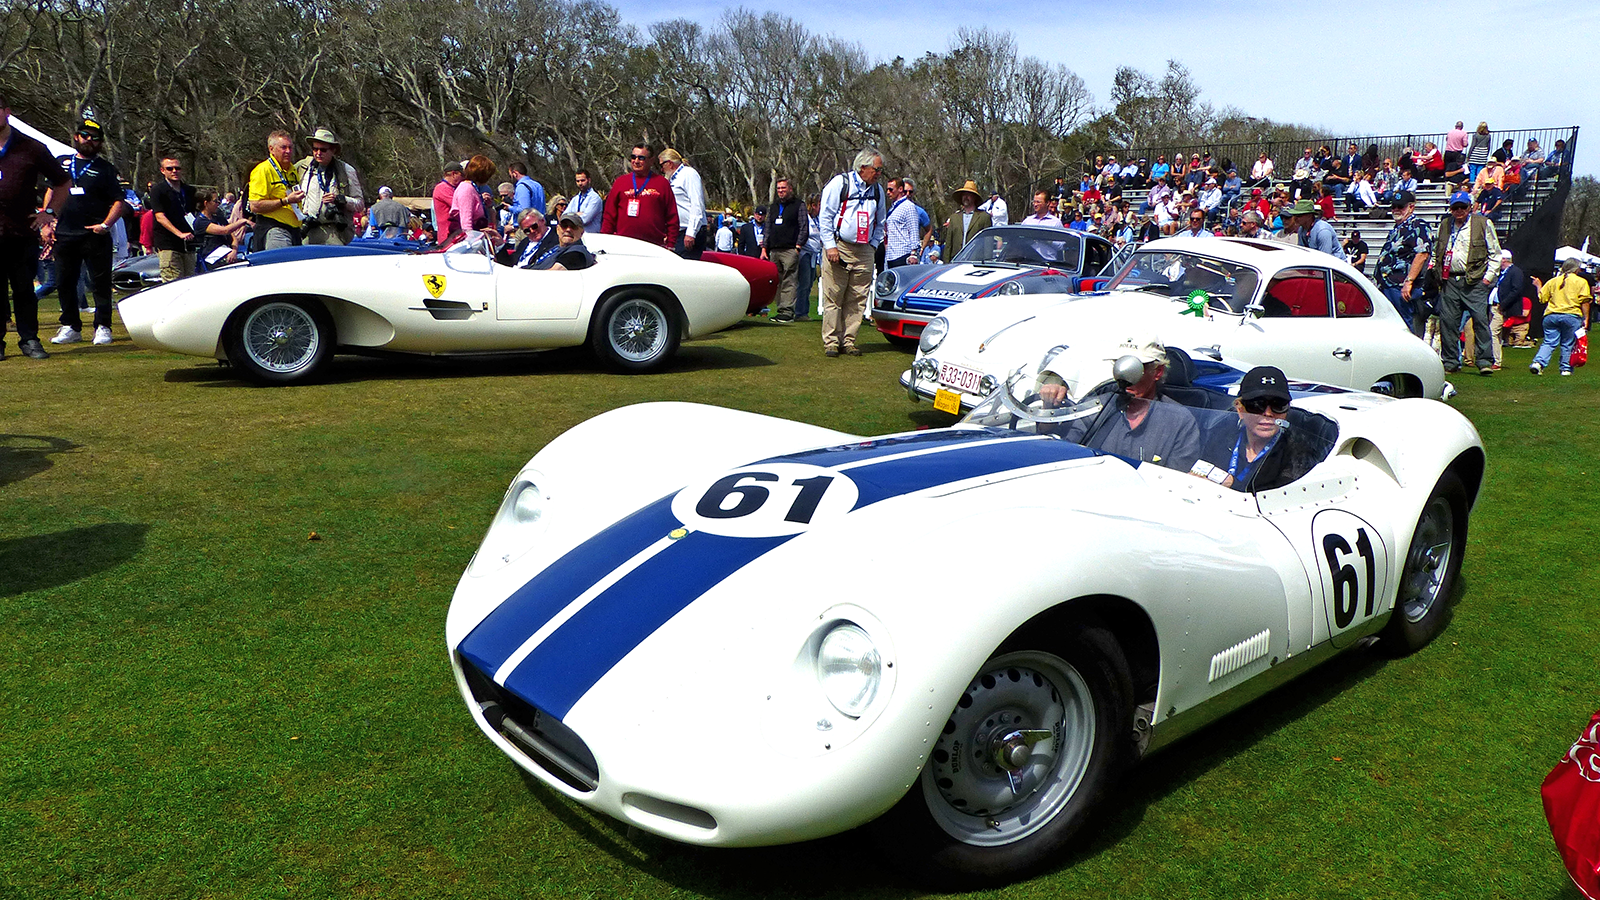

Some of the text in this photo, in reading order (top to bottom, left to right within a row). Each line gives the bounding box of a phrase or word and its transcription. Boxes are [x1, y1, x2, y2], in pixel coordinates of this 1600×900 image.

[916, 288, 973, 302] MARTINI
[695, 471, 835, 525] 61
[1322, 527, 1376, 629] 61
[951, 740, 960, 774] DUNLOP
